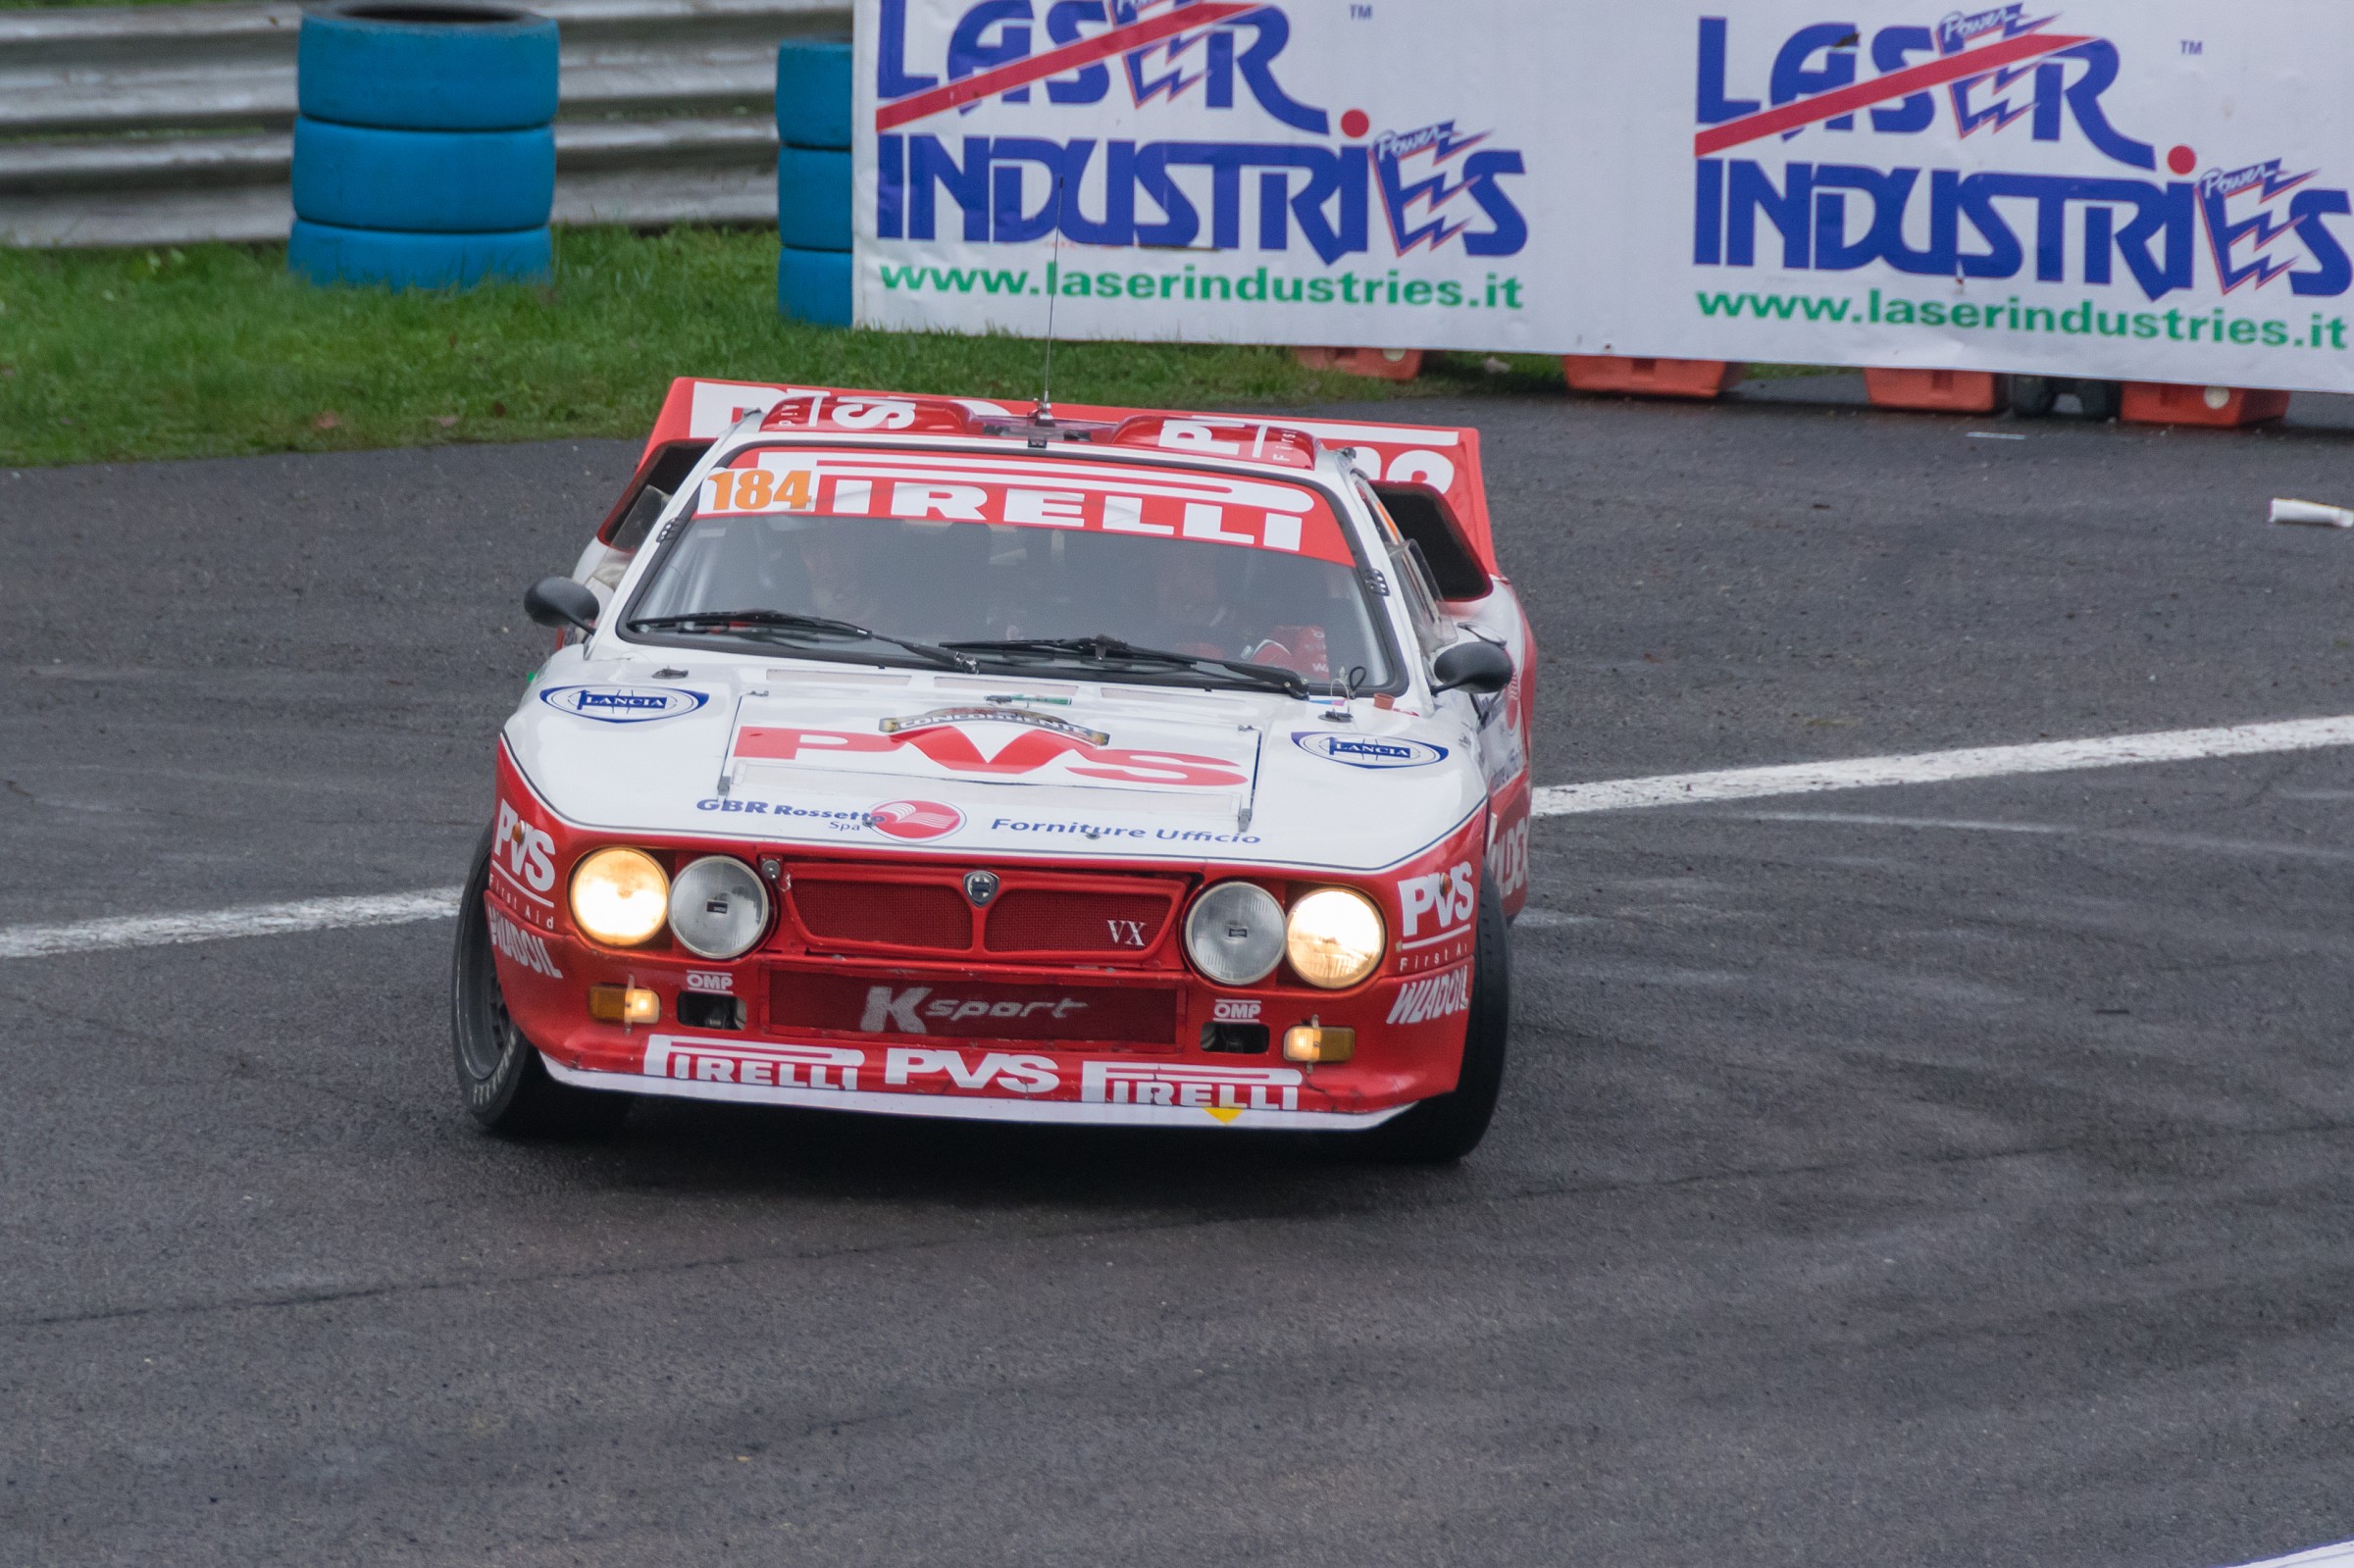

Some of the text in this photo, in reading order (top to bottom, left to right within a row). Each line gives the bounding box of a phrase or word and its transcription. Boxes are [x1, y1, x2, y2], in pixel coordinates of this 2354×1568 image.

[1350, 5, 1372, 20] TM
[877, 0, 1330, 136] LASER
[2180, 40, 2204, 55] TM
[1696, 3, 2156, 172] LASER
[877, 110, 1528, 266] INDUSTRIES
[1694, 145, 2353, 302] INDUSTRIES
[881, 262, 1524, 310] www.laserindustries.it
[1696, 289, 2347, 350] www.laserindustries.it
[708, 469, 812, 511] 184
[757, 452, 1314, 551] PIRELLI
[733, 726, 1248, 785] PVS
[1336, 742, 1408, 757] LANCIA
[696, 799, 886, 824] GBR Rossetto
[829, 821, 860, 832] Spa
[992, 819, 1261, 843] Forniture Ufficio
[493, 798, 556, 892] PVS
[1398, 861, 1474, 936] PVS
[1107, 920, 1147, 946] VX
[687, 973, 734, 989] OMP
[1213, 1001, 1261, 1019] OMP
[643, 1034, 865, 1090] PIRELLI
[885, 1047, 1060, 1093] PVS
[1081, 1061, 1303, 1110] PIRELLI
